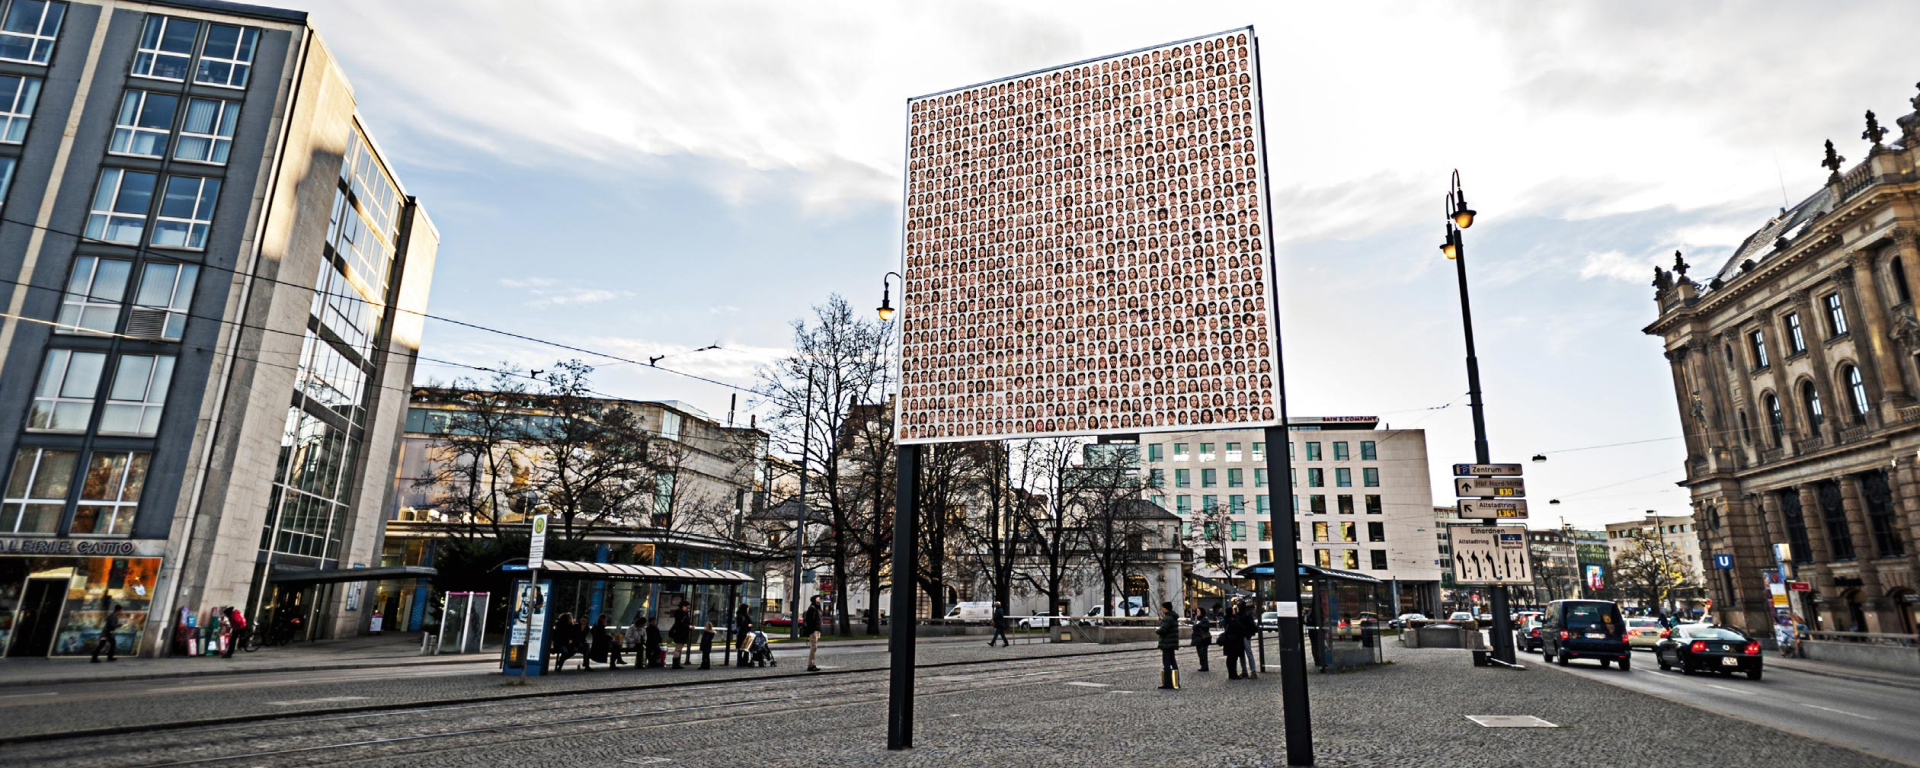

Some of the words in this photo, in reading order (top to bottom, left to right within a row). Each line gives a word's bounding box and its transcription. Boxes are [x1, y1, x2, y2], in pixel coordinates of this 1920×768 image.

[1497, 509, 1516, 517] 1364
[77, 541, 133, 554] CATTO
[1718, 556, 1729, 567] U
